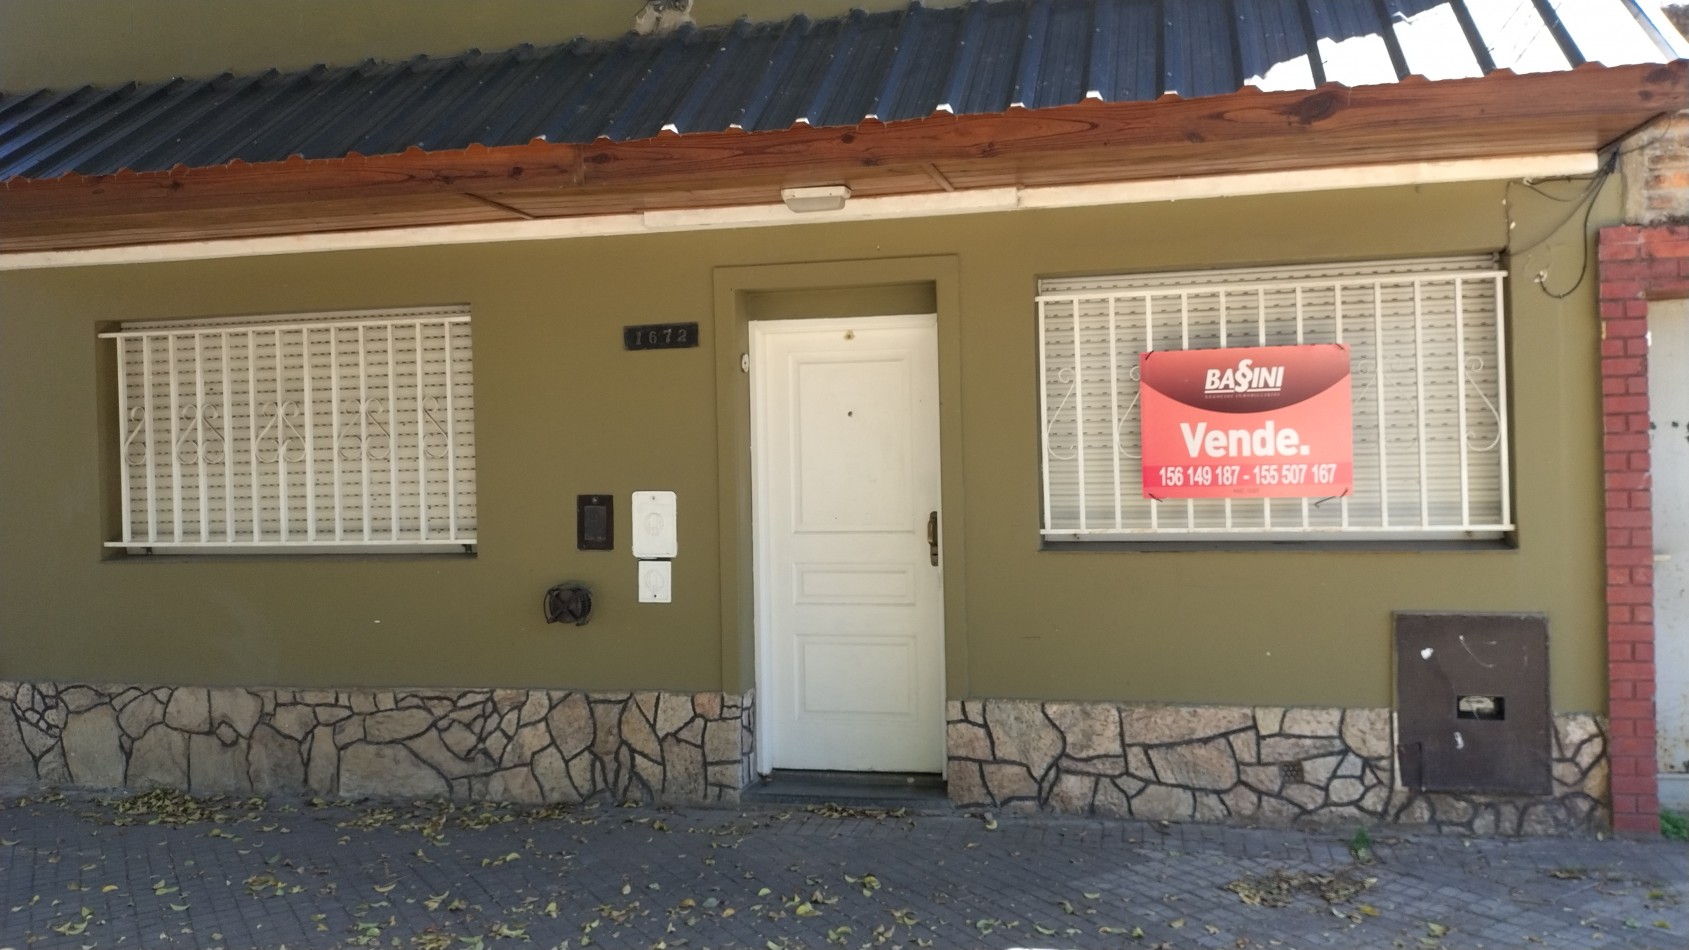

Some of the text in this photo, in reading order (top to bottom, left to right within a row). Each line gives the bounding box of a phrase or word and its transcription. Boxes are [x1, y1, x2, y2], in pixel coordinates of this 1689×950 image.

[635, 328, 687, 345] 1672
[1180, 420, 1310, 458] Vende.
[1159, 466, 1184, 486] 156
[1187, 466, 1212, 486] 149
[1215, 465, 1240, 485] 187
[1253, 465, 1279, 485] 155
[1281, 464, 1307, 484] 507
[1311, 463, 1337, 484] 167
